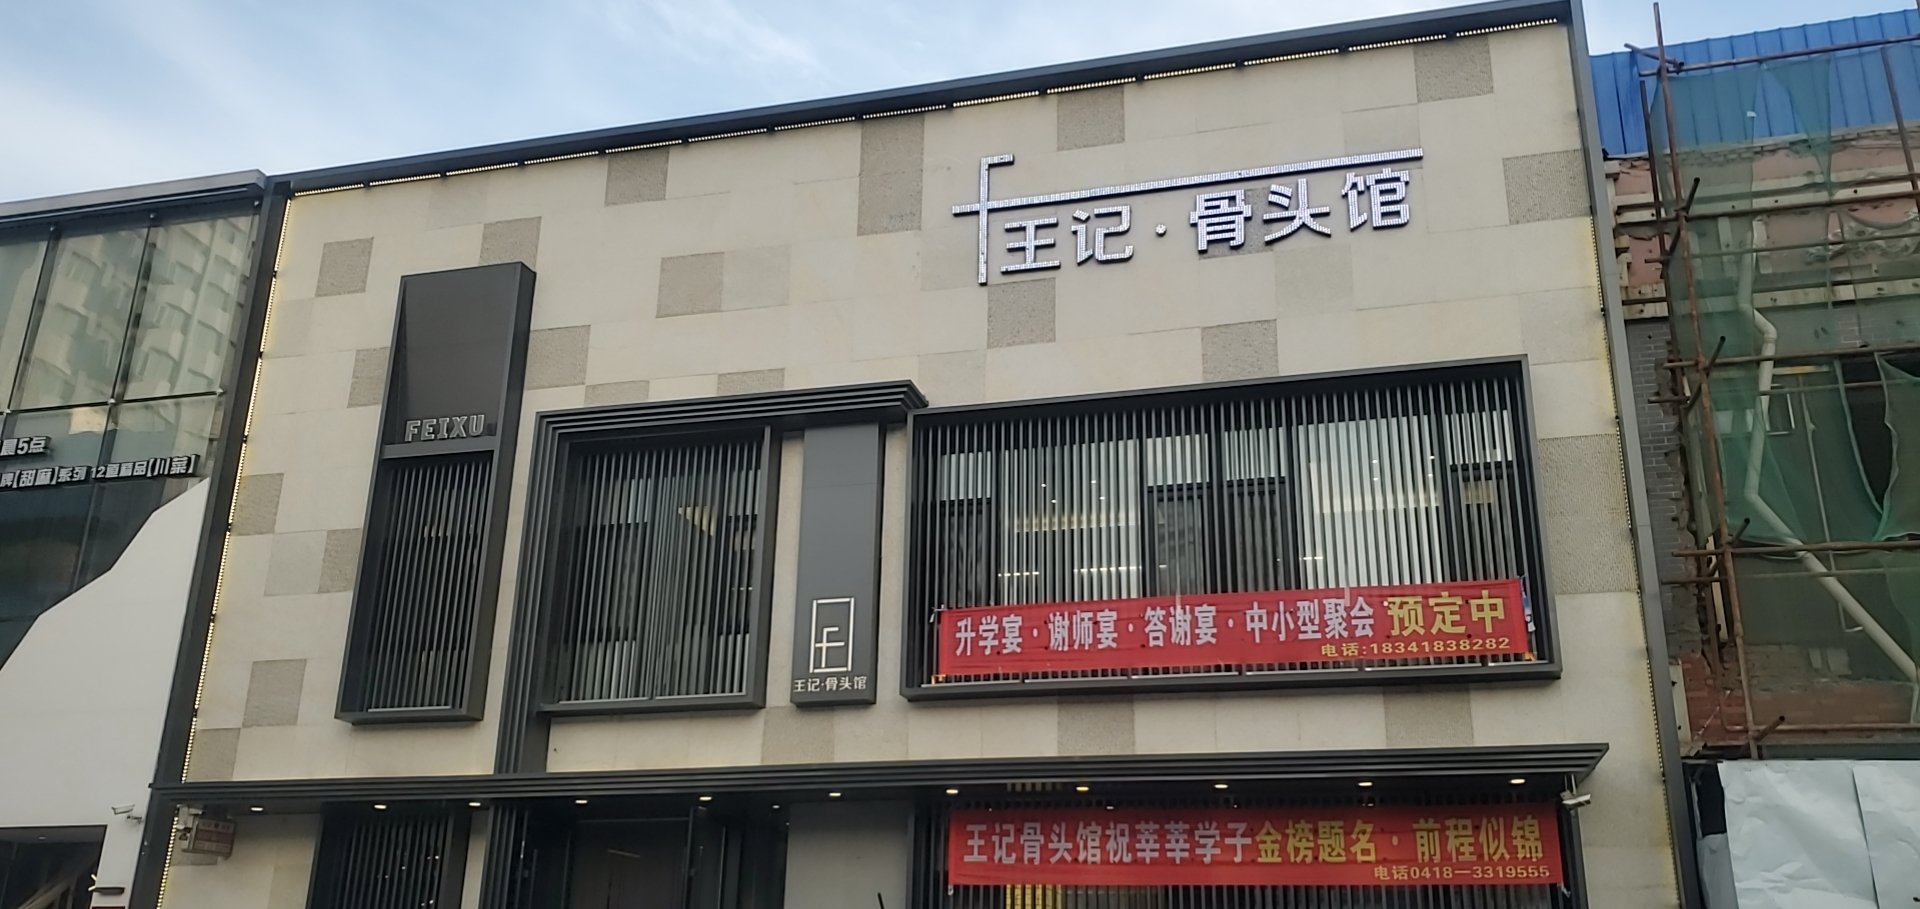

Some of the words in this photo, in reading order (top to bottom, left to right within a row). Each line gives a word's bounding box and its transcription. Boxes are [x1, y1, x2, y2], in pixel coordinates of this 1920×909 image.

[1000, 168, 1411, 272] 王记·骨头馆
[404, 414, 486, 442] FEIXU
[1387, 590, 1506, 637] 预定中
[792, 676, 868, 693] 王记·骨头馆
